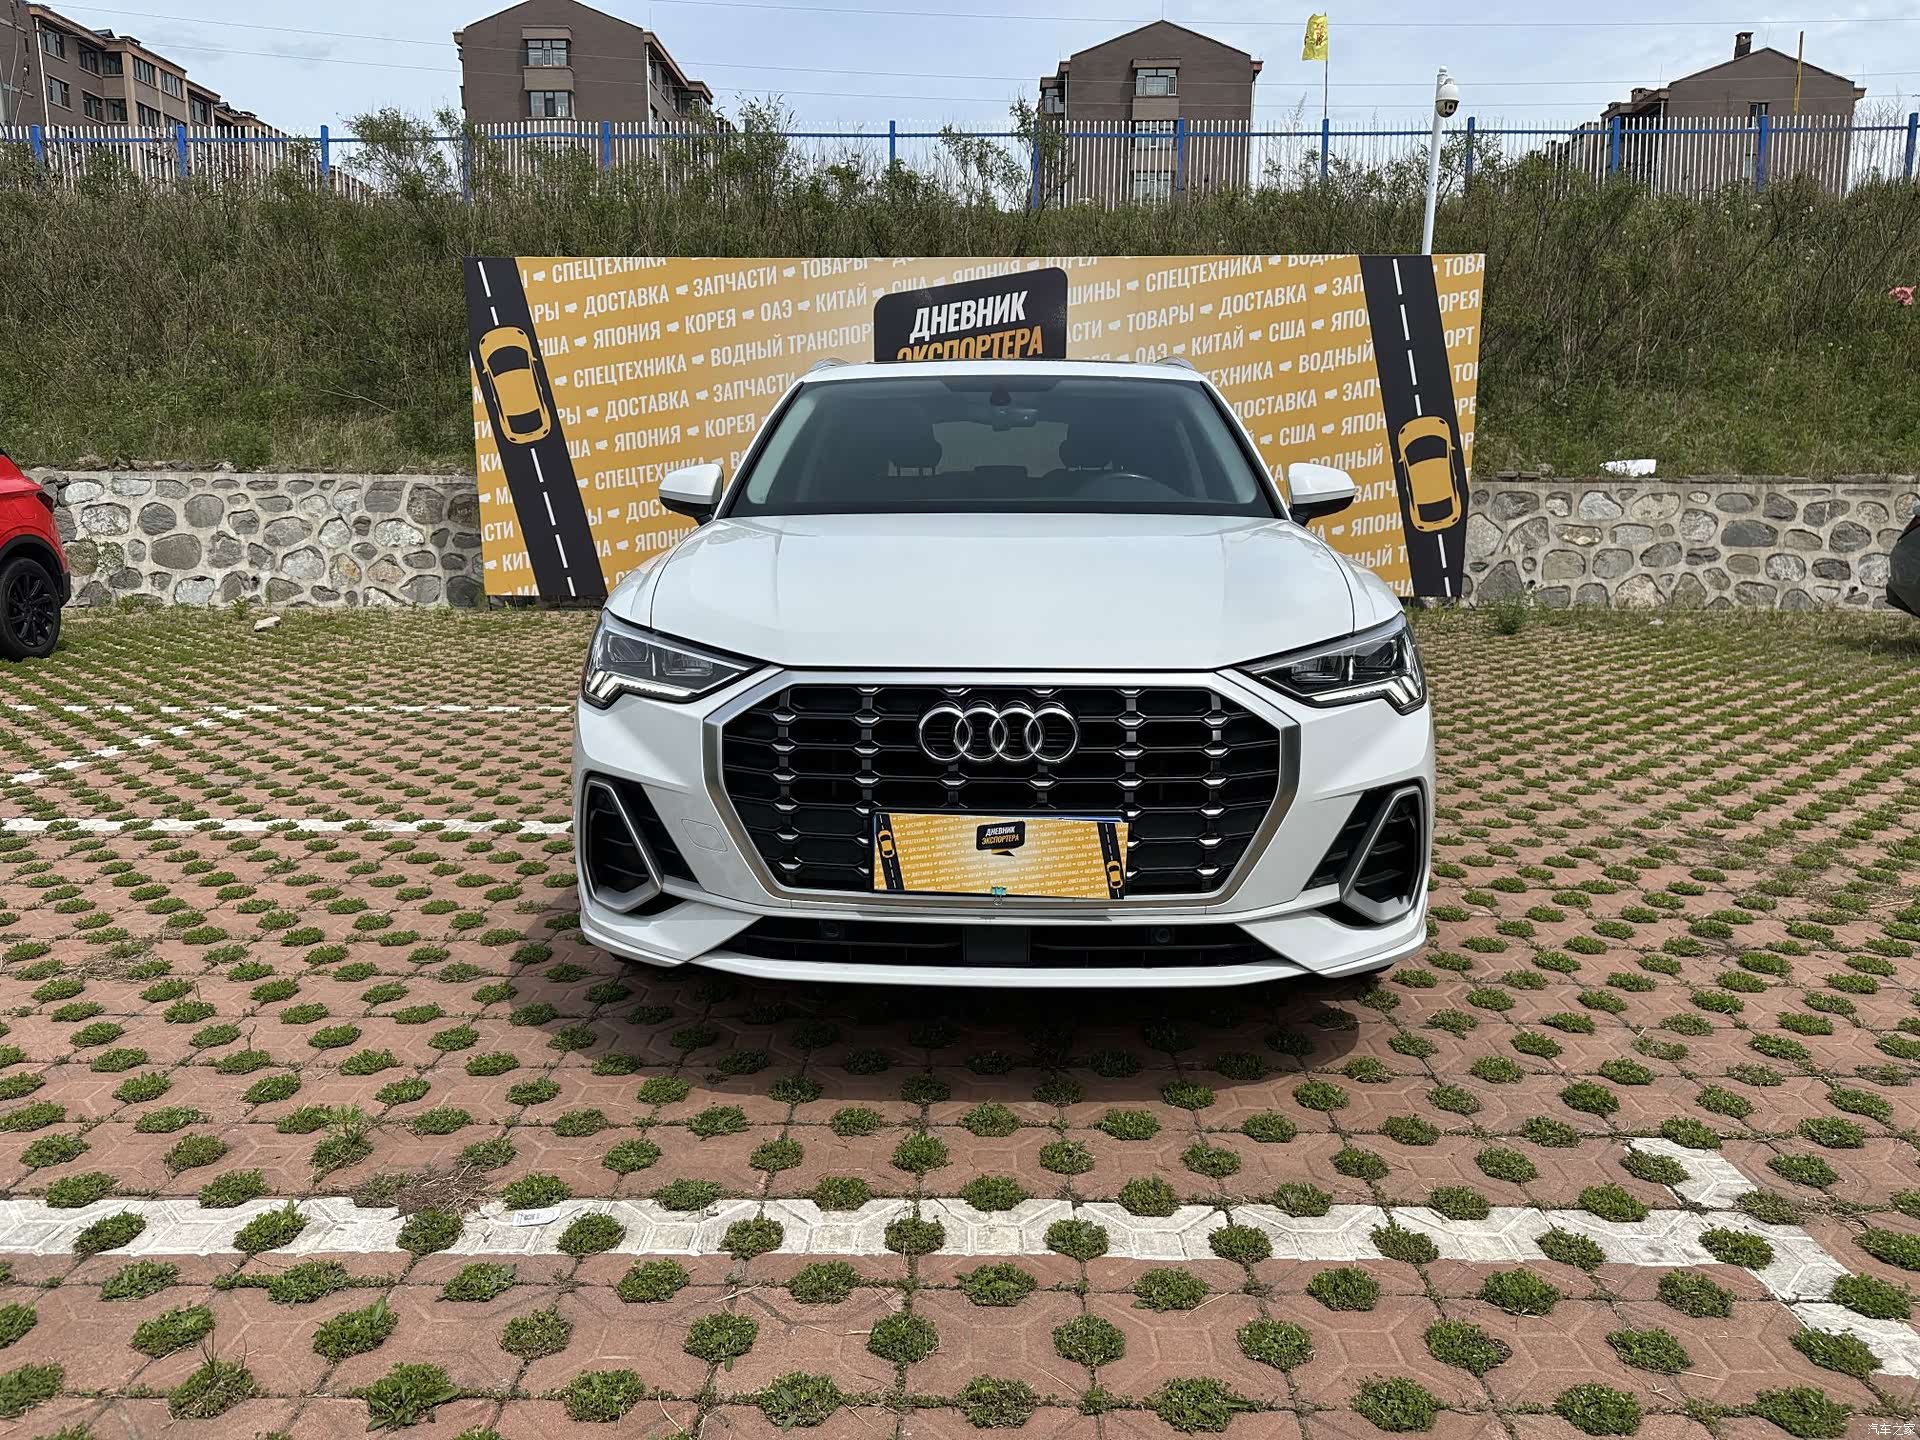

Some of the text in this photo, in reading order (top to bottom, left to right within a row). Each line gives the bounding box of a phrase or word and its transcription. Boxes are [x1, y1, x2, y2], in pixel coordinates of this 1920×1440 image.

[529, 257, 869, 324] РЫ ДОСТАВКА ЗАПЧАСТИ ТОВАРЫ
[552, 257, 667, 284] СПЕЦТЕХНИКА
[1145, 255, 1263, 293] СПЕЦТЕХНИКА
[593, 320, 661, 349] ЯПОНИЯ
[684, 308, 736, 335] КОРЕЯ
[760, 299, 793, 322] ОАЭ
[816, 282, 868, 313] КИТАЙ
[909, 290, 1028, 344] ДНЕВНИК
[1126, 303, 1195, 333] ТОВАРЫ
[1218, 283, 1307, 320] ДОСТАВКА
[1191, 325, 1244, 356] КИТАЙ
[1269, 318, 1306, 342] США
[1298, 338, 1375, 374] ВОДНЫЙ
[573, 354, 687, 388] СПЕЦТЕХНИКА
[710, 333, 783, 368] ВОДНЫЙ
[605, 389, 690, 423] ДОСТАВКА
[713, 371, 796, 403] ЗАПЧАСТИ
[614, 425, 681, 453] ЯПОНИЯ
[705, 412, 755, 438] КОРЕЯ
[1279, 423, 1316, 447] США
[985, 826, 1015, 837] ДНЕВНИК
